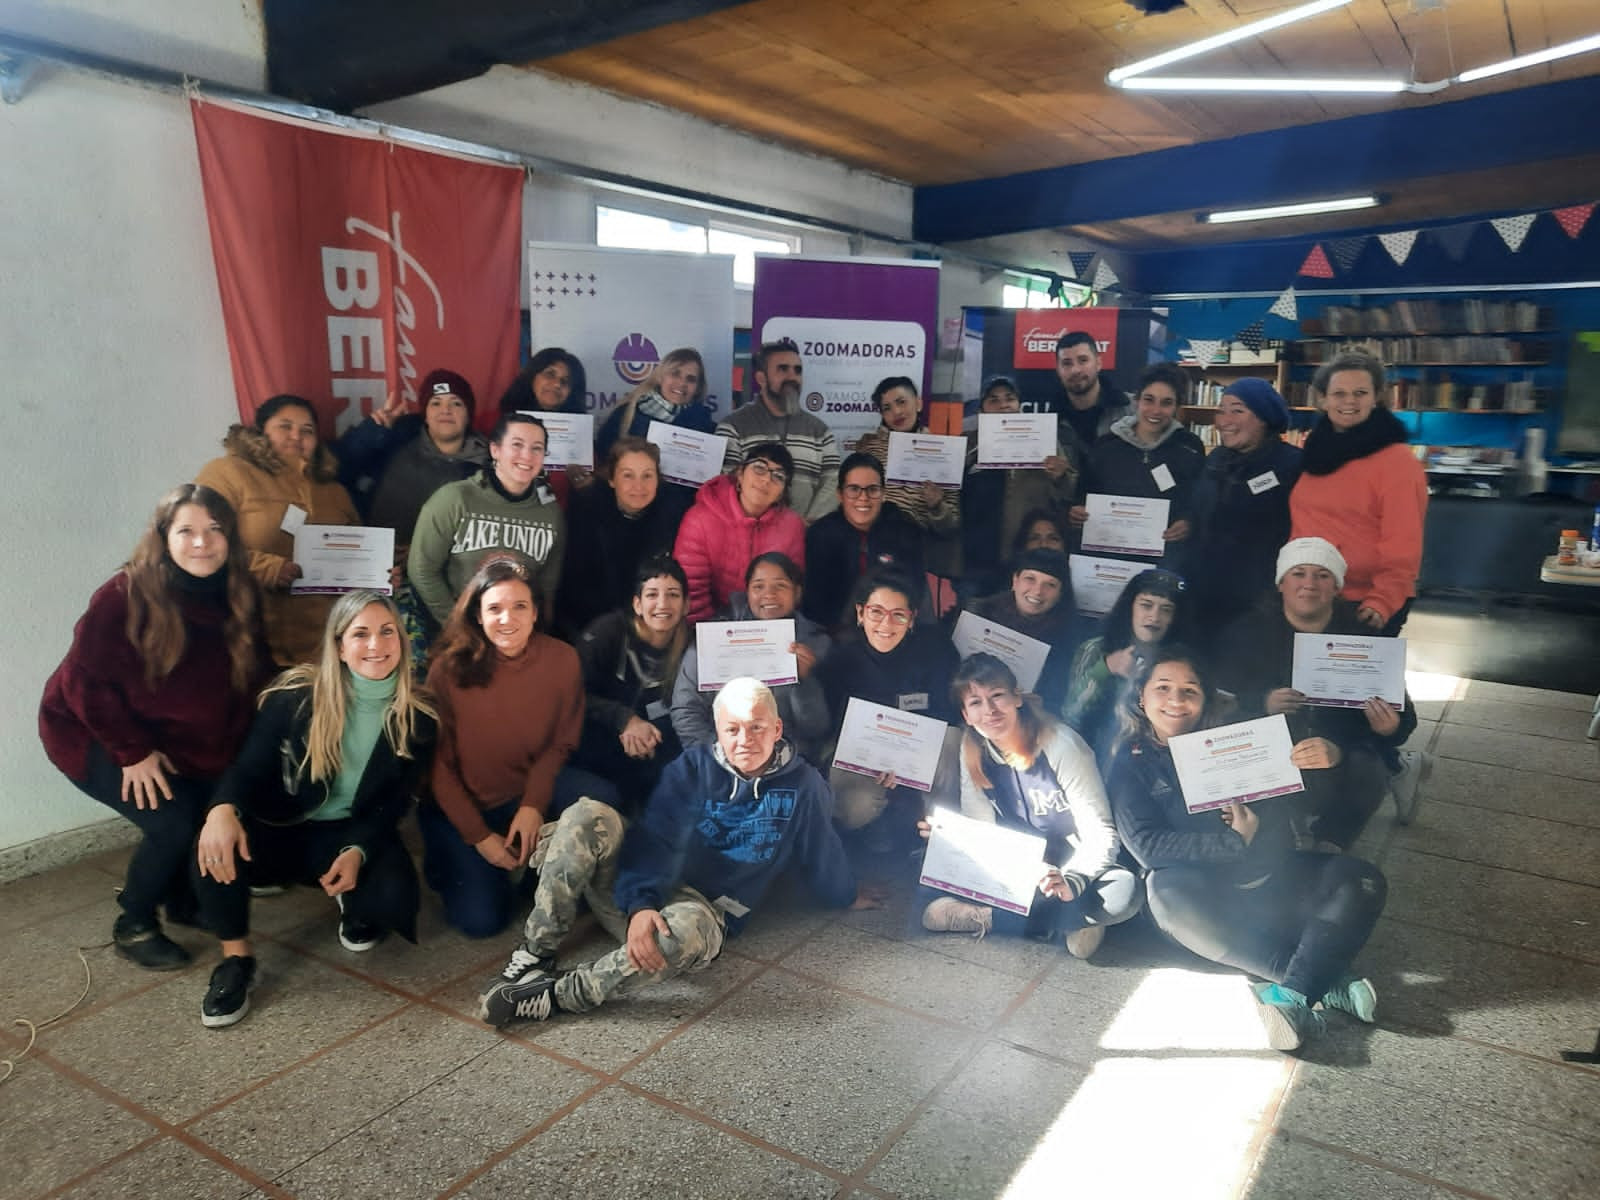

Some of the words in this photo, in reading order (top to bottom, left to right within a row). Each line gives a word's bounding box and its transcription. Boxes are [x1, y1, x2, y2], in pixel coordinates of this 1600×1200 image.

[321, 246, 388, 440] BER
[803, 341, 916, 358] ZOOMADORAS
[825, 391, 867, 402] VAMOS
[1029, 788, 1071, 816] M
